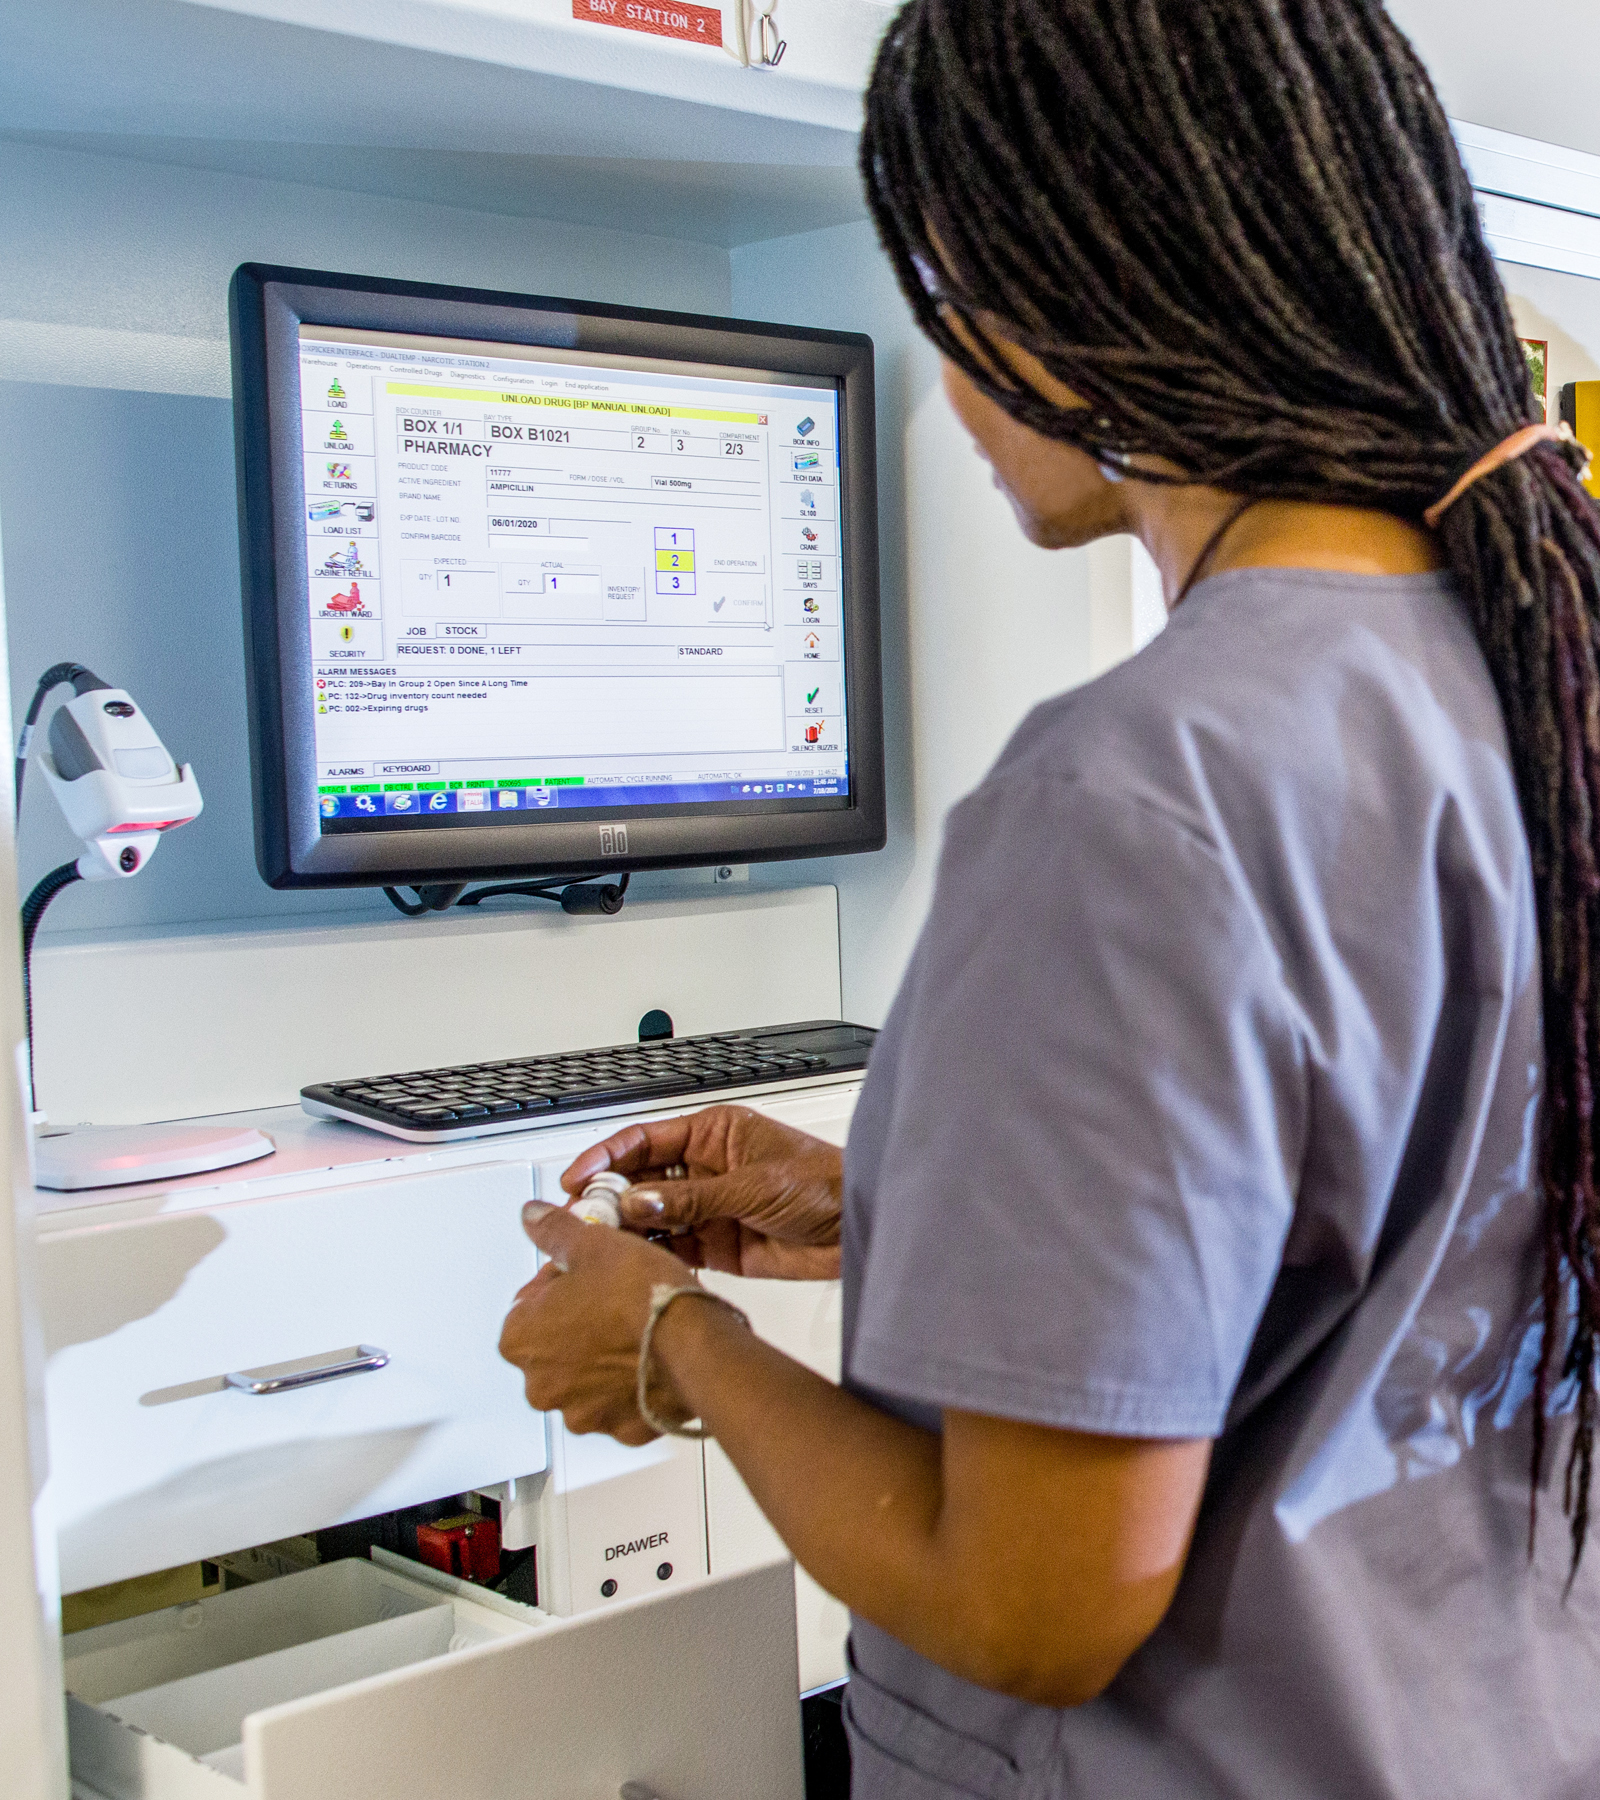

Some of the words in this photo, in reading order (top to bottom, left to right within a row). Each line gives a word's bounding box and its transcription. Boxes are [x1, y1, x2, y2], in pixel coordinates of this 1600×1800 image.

[626, 4, 688, 29] STATION
[697, 19, 705, 33] 2
[421, 356, 455, 366] NARCOTIC
[345, 361, 382, 372] Operations
[389, 365, 423, 375] Controlled
[424, 368, 443, 377] Drugs
[450, 371, 486, 381] Diagnostics
[493, 375, 535, 385] Configuration
[541, 379, 558, 387] Login
[565, 381, 576, 389] End
[577, 383, 609, 392] application
[327, 400, 348, 408] LOAD
[501, 394, 542, 405] UNLOAD
[544, 397, 571, 407] DRUG
[591, 402, 629, 413] MANUAL
[631, 405, 671, 417] UNLOAD]
[403, 418, 438, 433] BOX
[443, 422, 463, 435] 1/1
[491, 425, 524, 440] BOX
[528, 427, 570, 443] B1021
[324, 442, 354, 451] UNLOAD
[637, 436, 645, 449] 2
[677, 439, 684, 451] 3
[806, 439, 820, 447] INFO
[404, 440, 493, 457] PHARMACY
[725, 442, 744, 455] 2/3
[398, 462, 429, 471] PRODUCT
[431, 464, 449, 472] CODE
[490, 469, 511, 477] 11777
[398, 477, 421, 485] ACTIVE
[423, 478, 461, 487] INGREDIENT
[654, 478, 668, 486] Vial
[669, 480, 692, 489] 500mg
[793, 474, 807, 482] TECH
[808, 475, 823, 483] DATA
[323, 481, 357, 490] RETURNS
[490, 483, 534, 492] AMPICILLIN
[399, 492, 422, 500] BRAND
[423, 493, 441, 501] NAME
[414, 514, 431, 522] DATE
[492, 518, 538, 529] 06/01/2020
[323, 526, 344, 534] LOAD
[345, 527, 362, 535] LIST
[671, 533, 677, 545] 1
[671, 554, 679, 567] 2
[349, 569, 374, 577] REFILL
[444, 574, 451, 587] 1
[551, 577, 557, 589] 1
[672, 577, 680, 589] 3
[318, 610, 349, 618] URGENT
[351, 610, 373, 618] WARD
[406, 627, 427, 636] JOB
[445, 626, 478, 635] STOCK
[329, 650, 365, 658] SECURITY
[397, 646, 446, 655] REQUEST:
[457, 646, 488, 655] DONE,
[498, 647, 522, 655] LEFT
[679, 648, 723, 656] STANDARD
[317, 668, 347, 676] ALARM
[350, 668, 396, 676] MESSAGES
[327, 680, 347, 688] PLC:
[398, 680, 425, 689] Group
[434, 680, 456, 689] Open
[488, 680, 508, 689] Long
[510, 679, 528, 687] Time
[389, 692, 429, 700] inventory
[431, 692, 455, 700] count
[404, 704, 429, 713] drugs
[327, 767, 364, 777] ALARMS
[382, 764, 431, 774] KEYBOARD
[604, 1531, 670, 1561] DRAWER
